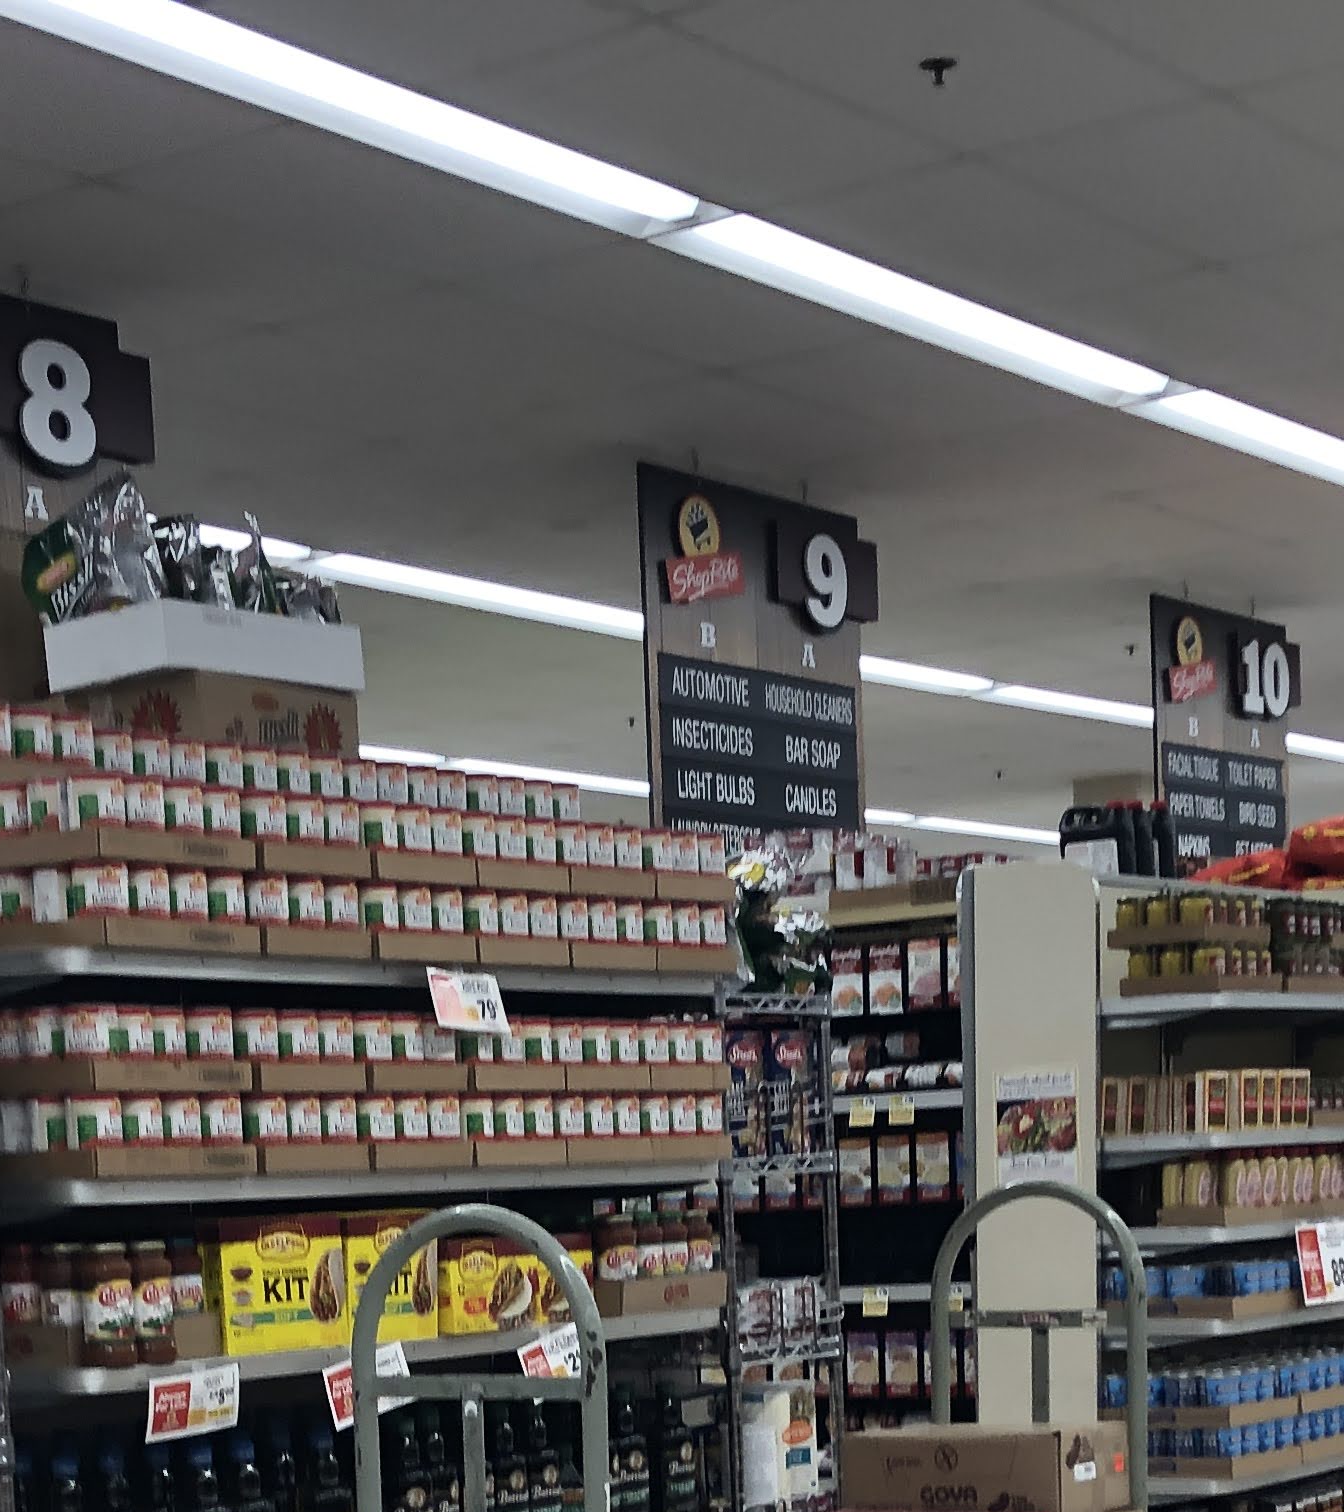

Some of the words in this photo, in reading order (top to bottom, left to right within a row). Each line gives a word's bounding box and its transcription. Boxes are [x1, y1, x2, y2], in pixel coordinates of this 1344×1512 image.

[19, 338, 96, 467] 8
[25, 485, 49, 520] A
[805, 533, 847, 628] 9
[700, 622, 716, 648] B
[802, 644, 816, 669] A
[672, 667, 750, 707] AUTOMOTIVE
[1242, 640, 1290, 718] 10
[765, 683, 813, 719] HOUSEHOLD
[813, 693, 853, 725] CLEANERS
[672, 717, 753, 757] INSECTICIDES
[1188, 716, 1199, 737] B
[1250, 728, 1260, 748] A
[785, 735, 810, 765] BAR
[811, 739, 841, 770] SOAP
[678, 770, 713, 802] LIGHT
[716, 773, 755, 806] BULBS
[1228, 761, 1253, 788] TOILET
[785, 784, 837, 818] CANDLES
[1169, 791, 1195, 818] PAPER
[1195, 794, 1226, 821] TOWELS
[263, 1275, 309, 1304] KIT
[384, 1270, 413, 1297] IT
[920, 1485, 978, 1505] GOYA
